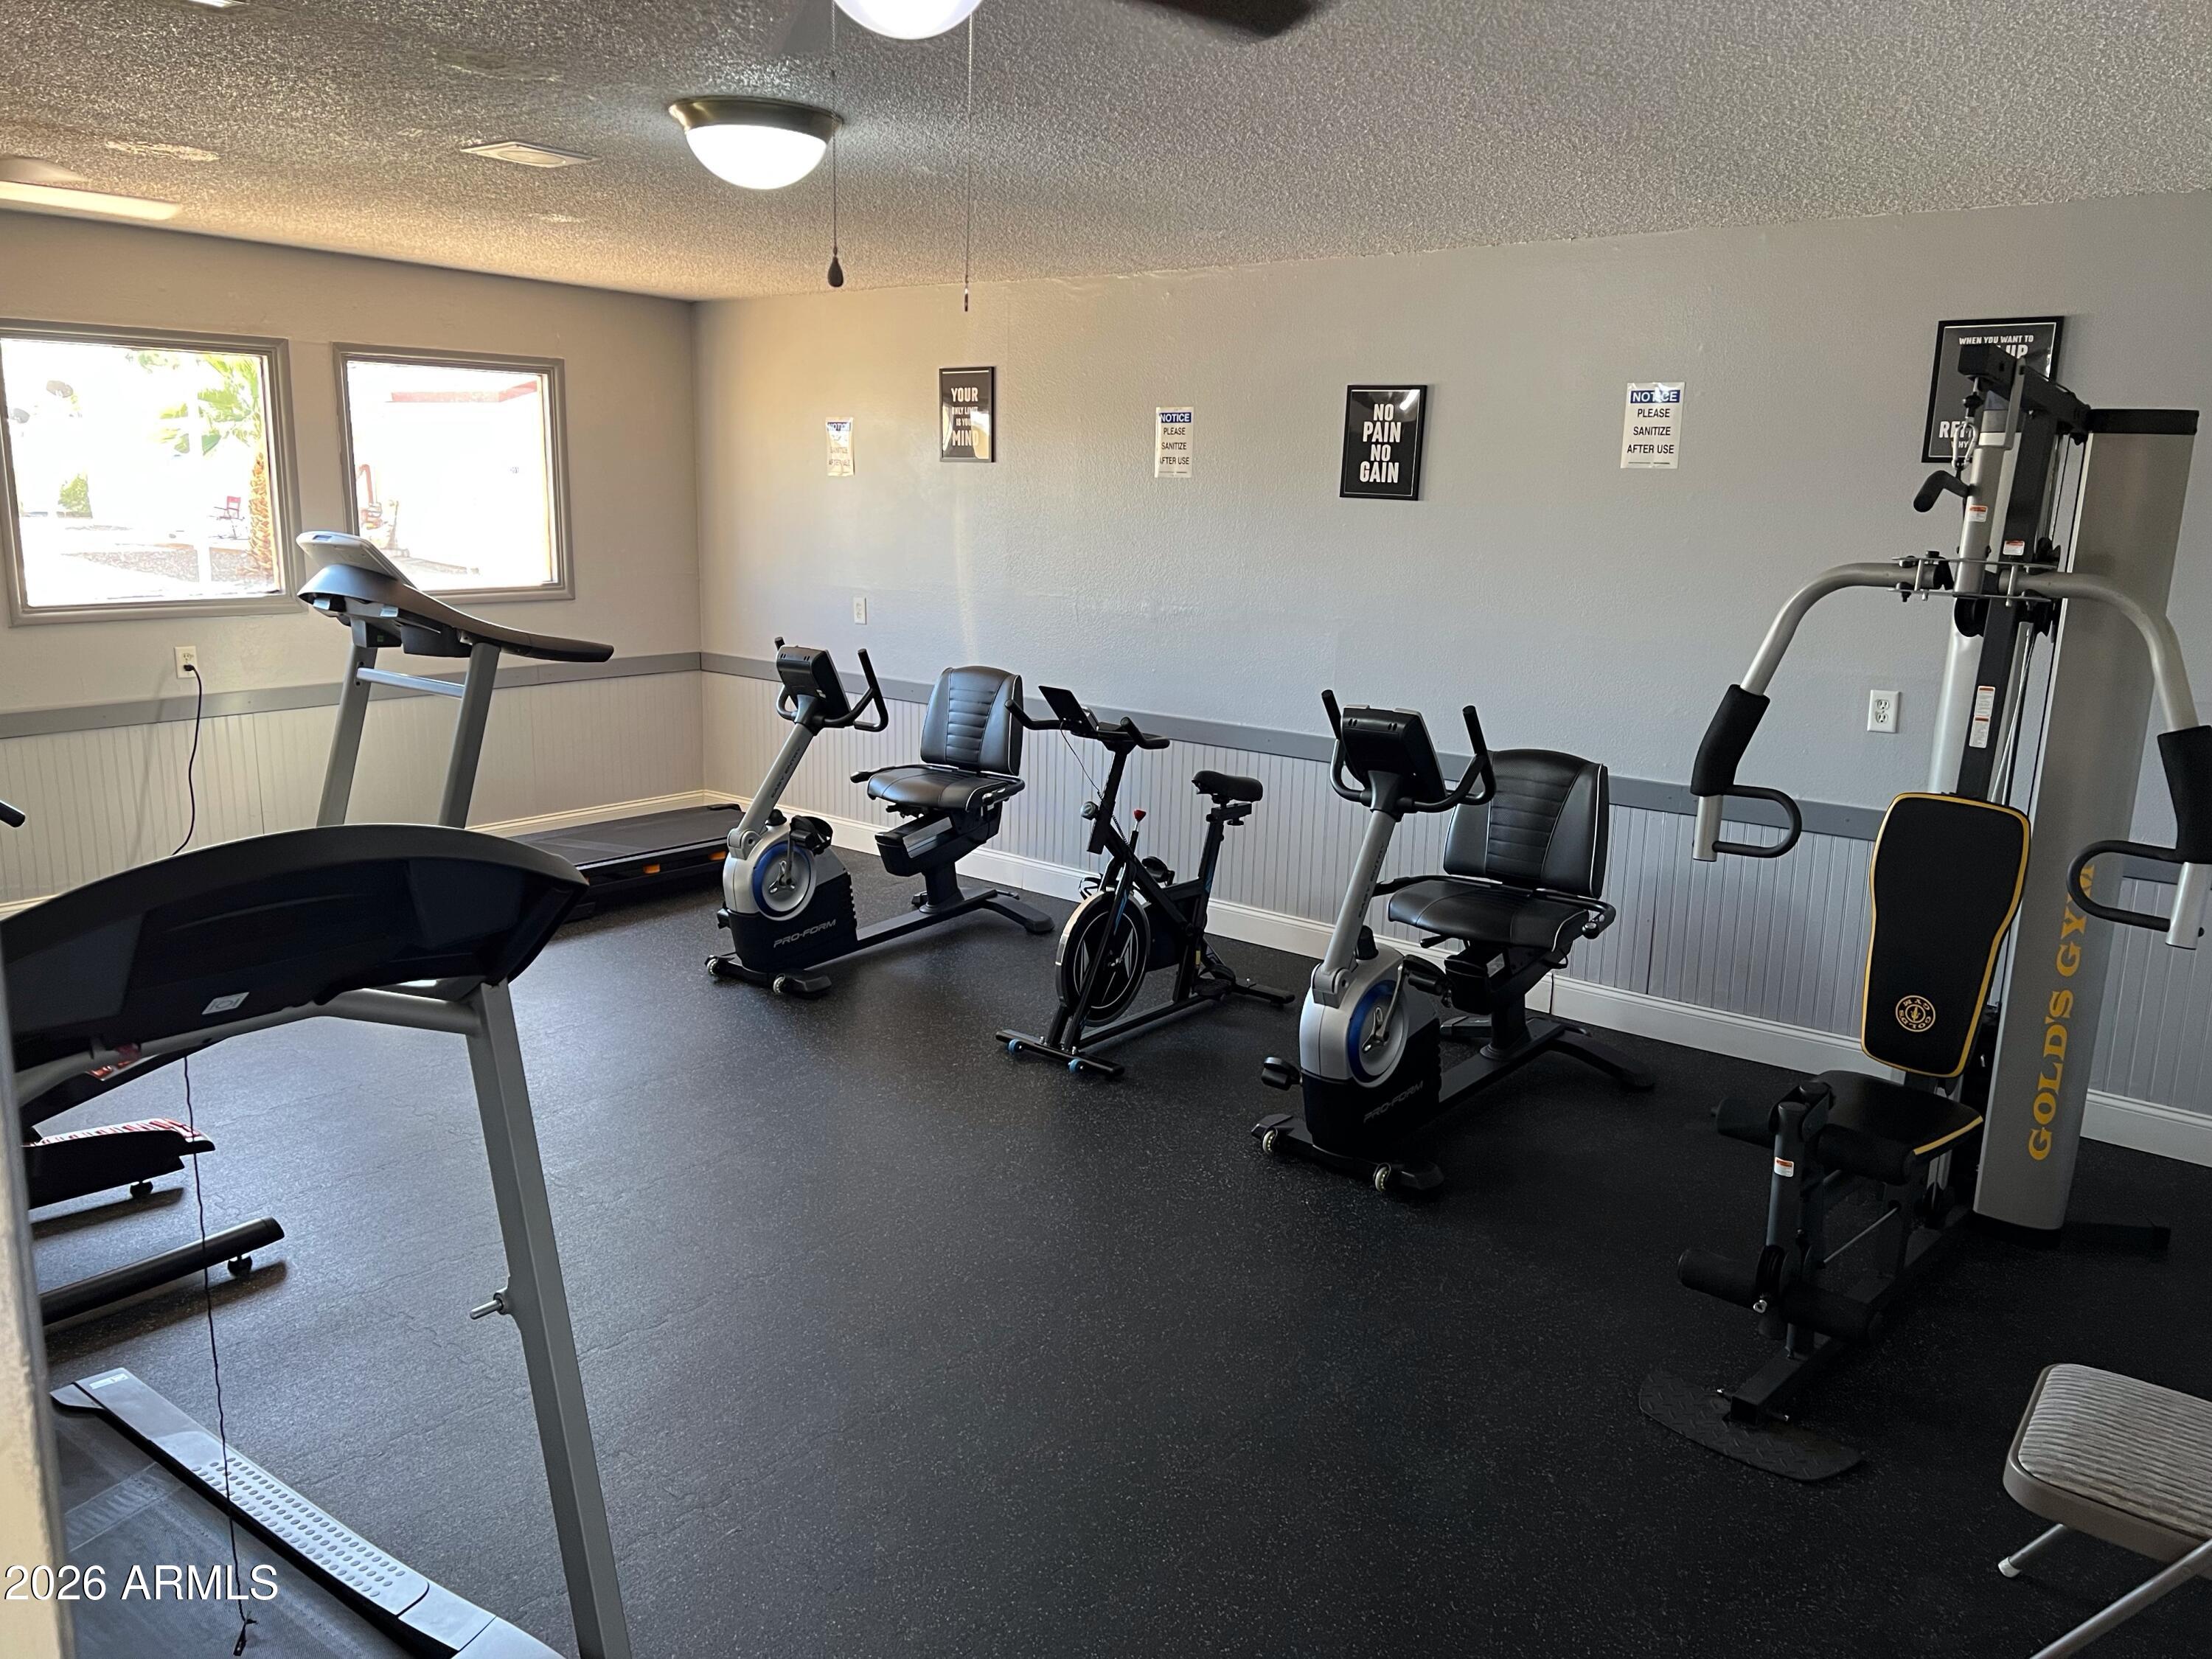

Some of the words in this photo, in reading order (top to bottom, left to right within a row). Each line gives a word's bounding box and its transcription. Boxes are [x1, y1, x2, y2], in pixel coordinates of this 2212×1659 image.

[1959, 336, 1982, 345] WHEN
[1983, 335, 1999, 344] YOU
[2000, 335, 2023, 344] WANT
[2025, 334, 2034, 343] TO
[950, 387, 978, 402] YOUR
[951, 406, 964, 415] ONLY
[1160, 413, 1189, 422] NOTICE
[1373, 403, 1394, 421] NO
[1637, 408, 1671, 417] PLEASE
[956, 418, 961, 427] IS
[952, 430, 979, 446] MIND
[1363, 421, 1402, 442] PAIN
[1633, 426, 1671, 436] SANITIZE
[1161, 442, 1187, 451] SANITIZE
[1370, 444, 1391, 462] NO
[1627, 445, 1654, 453] AFTER
[1657, 445, 1674, 454] USE
[1360, 461, 1399, 484] GAIN
[773, 919, 836, 948] PRO-FORM
[2028, 989, 2075, 1161] GOLD'S
[1363, 1080, 1424, 1124] PRO-FORM
